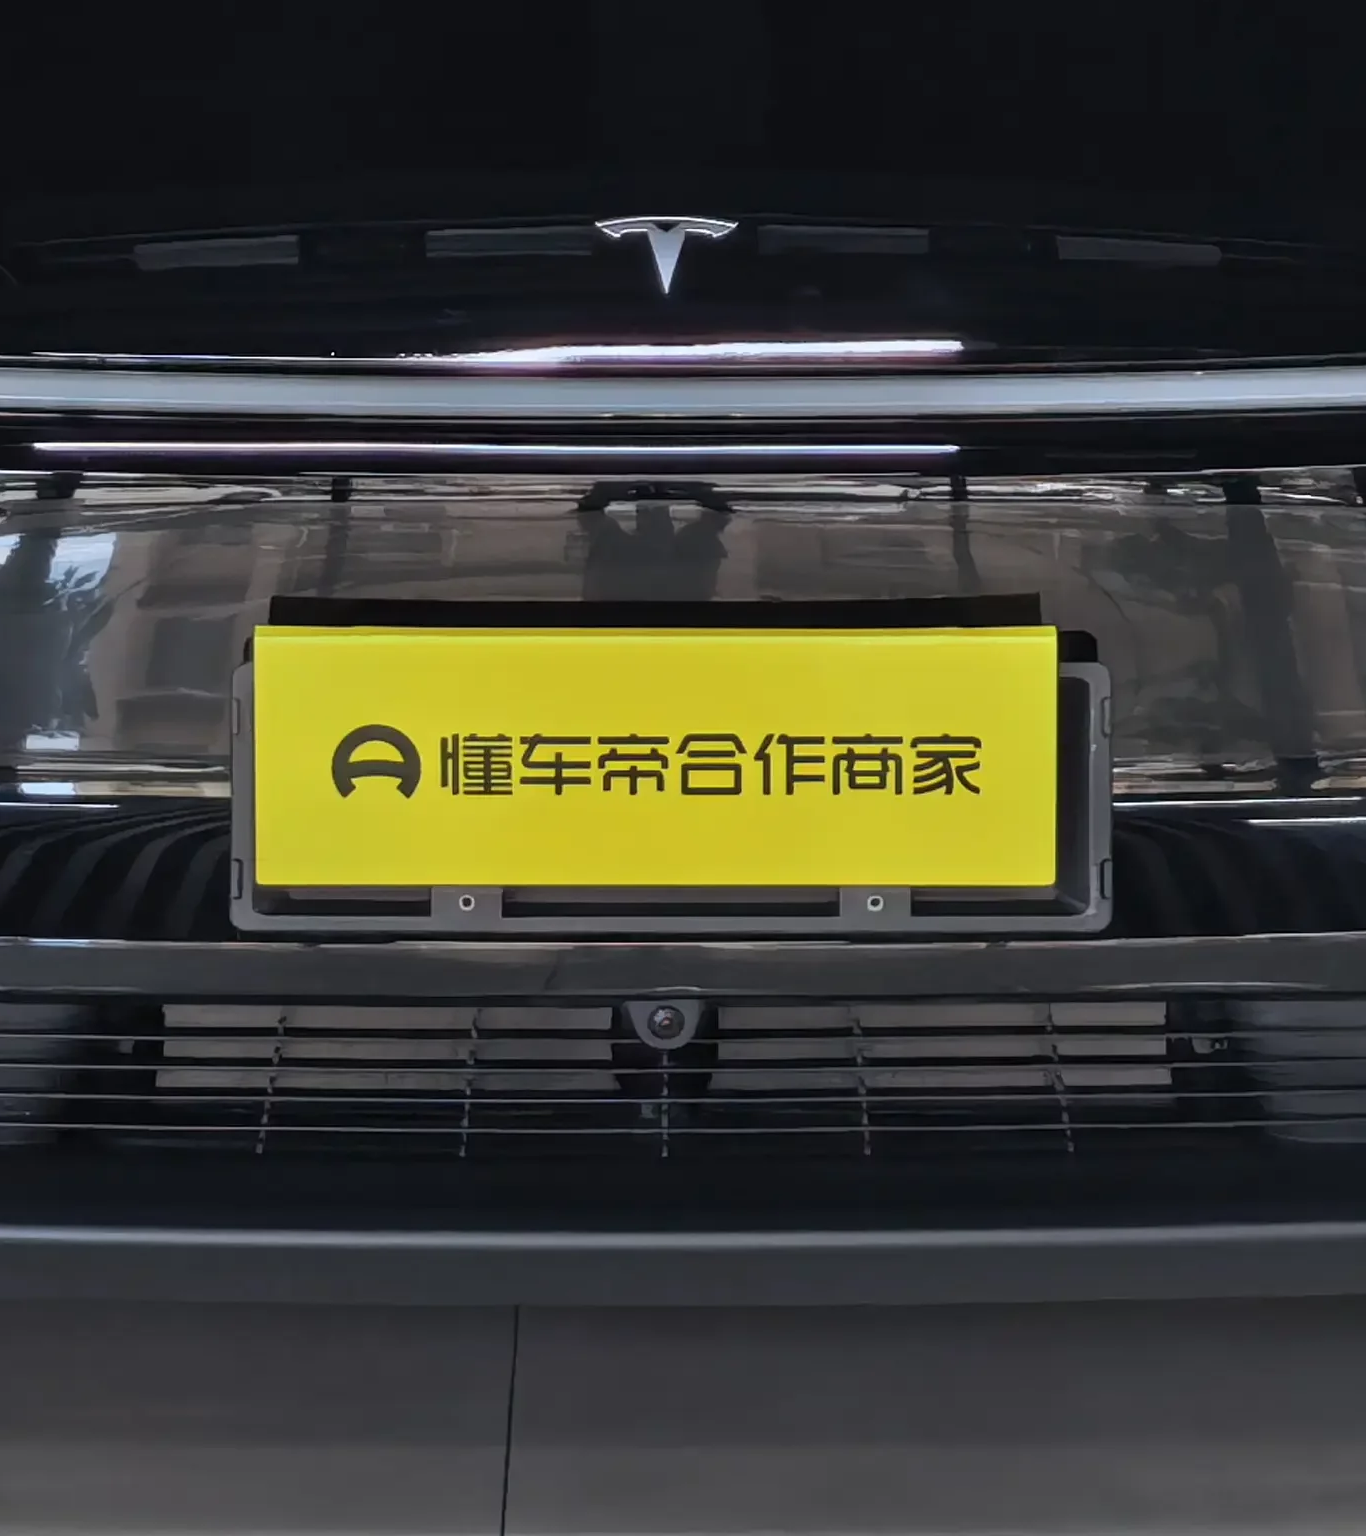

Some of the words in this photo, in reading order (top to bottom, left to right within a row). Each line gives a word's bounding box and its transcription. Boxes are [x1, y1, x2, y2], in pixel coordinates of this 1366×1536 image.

[440, 732, 982, 796] 懂车帝合作商家
